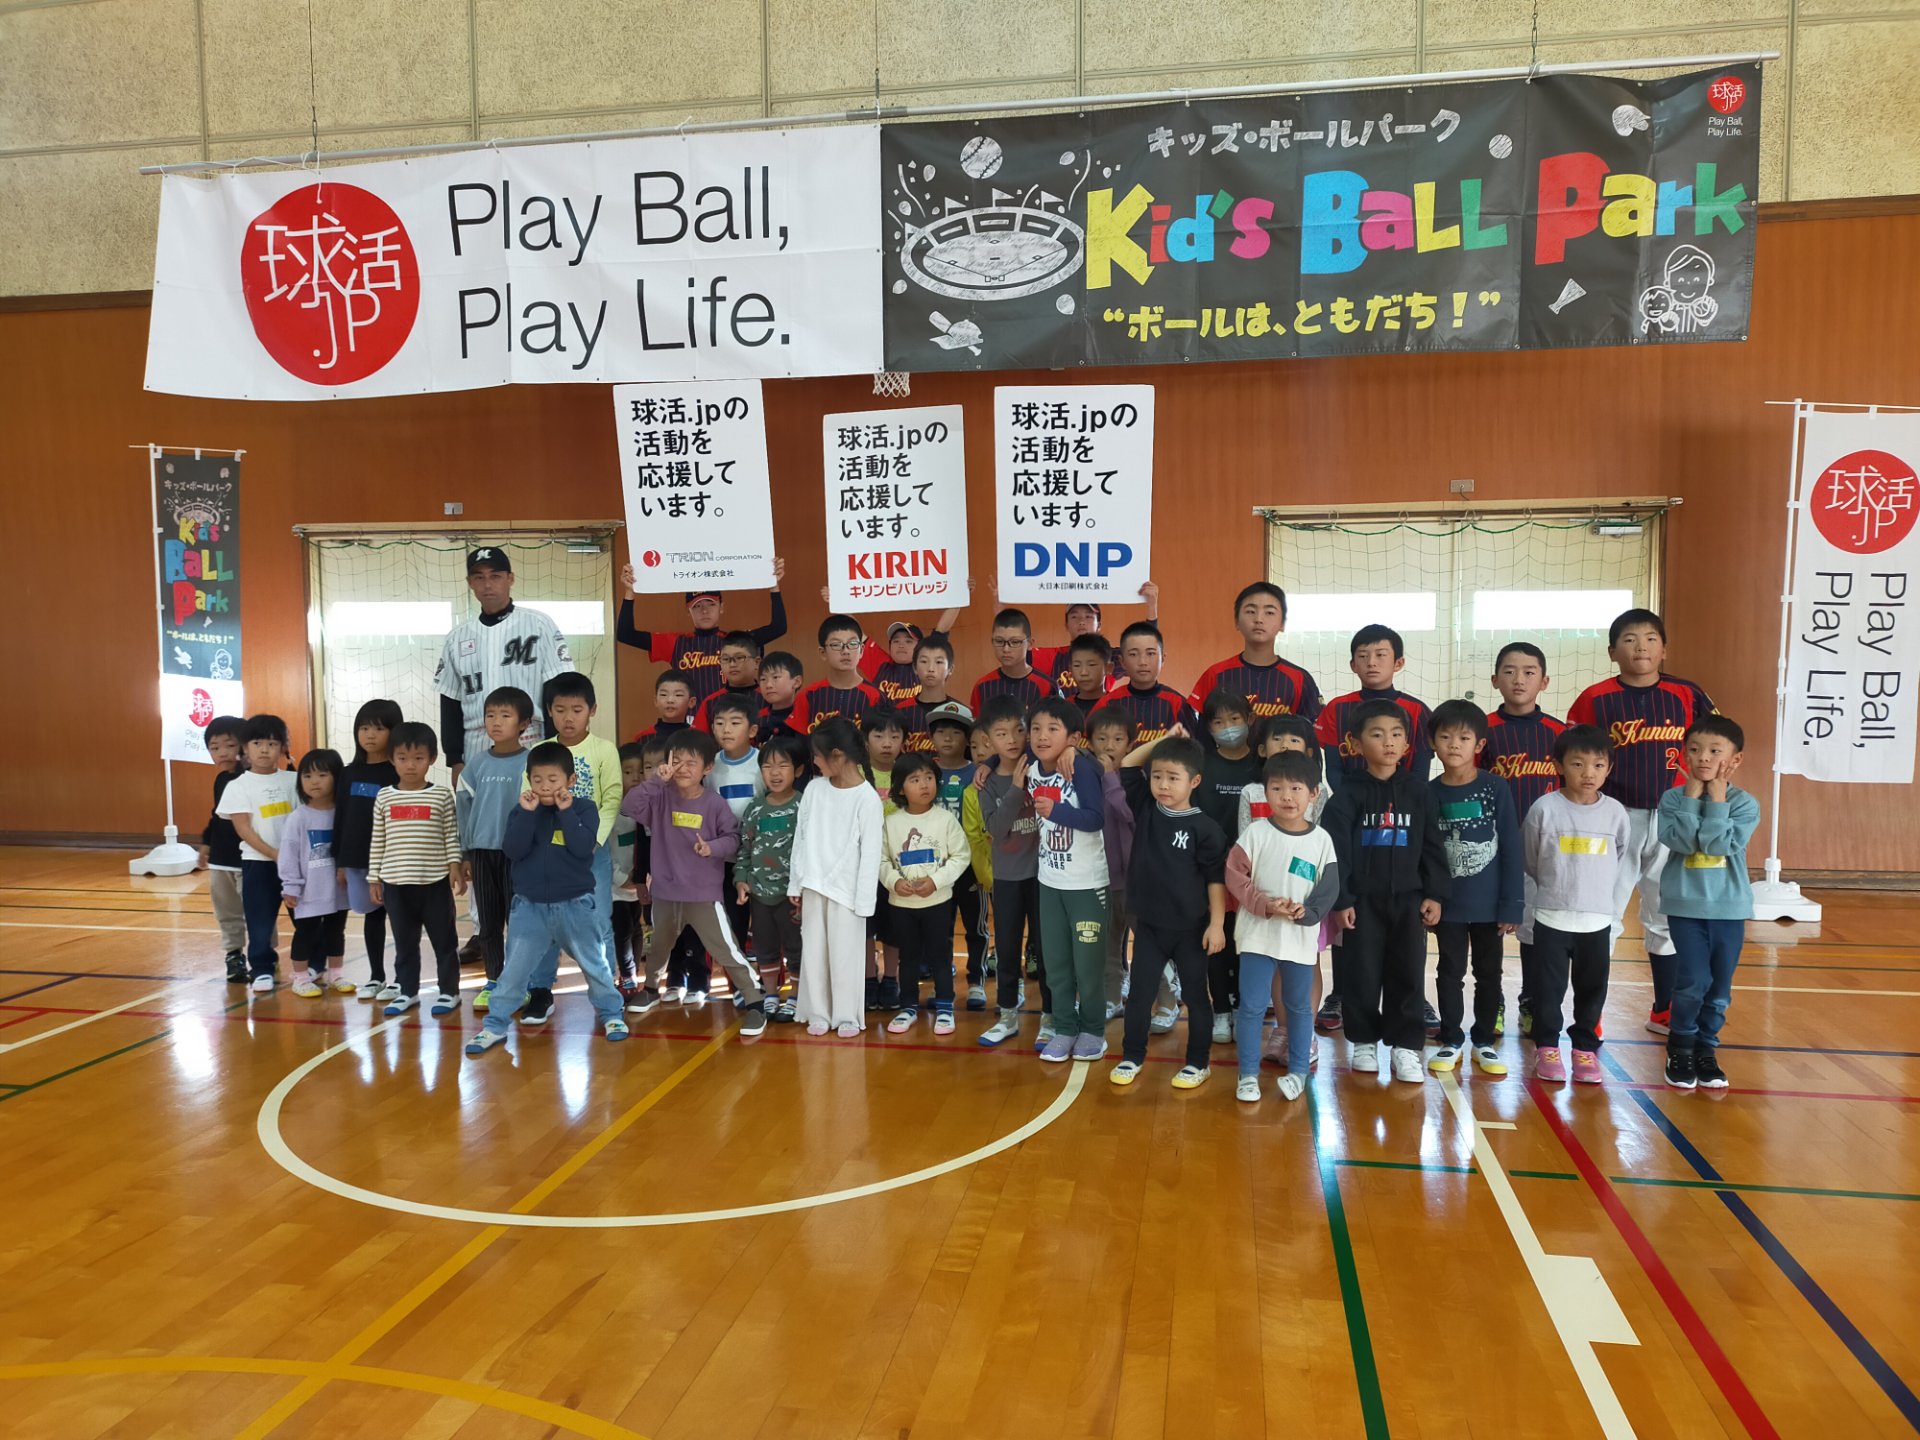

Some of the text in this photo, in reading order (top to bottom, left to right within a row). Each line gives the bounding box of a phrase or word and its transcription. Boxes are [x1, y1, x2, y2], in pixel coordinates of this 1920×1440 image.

[1148, 108, 1461, 157] キッズ・ボールパーク
[1707, 127, 1725, 138] Play
[1708, 116, 1726, 127] Play
[448, 166, 790, 266] Play Ball,
[1086, 183, 1275, 290] Kid's
[1534, 152, 1748, 265] Park
[254, 211, 403, 304] 球活
[458, 275, 791, 370] Play Life.
[631, 397, 749, 425] 球活.jpの
[1012, 402, 1138, 433] 球活.jpの
[634, 428, 713, 457] 活動を
[838, 422, 949, 451] 球活.jpの
[1012, 436, 1095, 463] 活動を
[638, 460, 736, 489] 応援して
[838, 452, 912, 481] 活動を
[839, 482, 934, 512] 応援して
[1012, 469, 1119, 496] 応援して
[1825, 464, 1915, 514] 球活
[641, 491, 724, 518] います。
[1013, 501, 1097, 528] います。
[841, 513, 920, 539] います。
[476, 549, 492, 561] M
[666, 551, 714, 563] TRION
[848, 549, 948, 581] KIRIN
[1014, 542, 1133, 577] DNP
[850, 581, 948, 598] キリンビバレッジ
[1038, 582, 1109, 590] 大日本印刷株式会社
[501, 635, 541, 666] M
[1802, 571, 1853, 746] Play Life.
[1852, 573, 1907, 748] Play Ball,
[461, 672, 483, 695] 11
